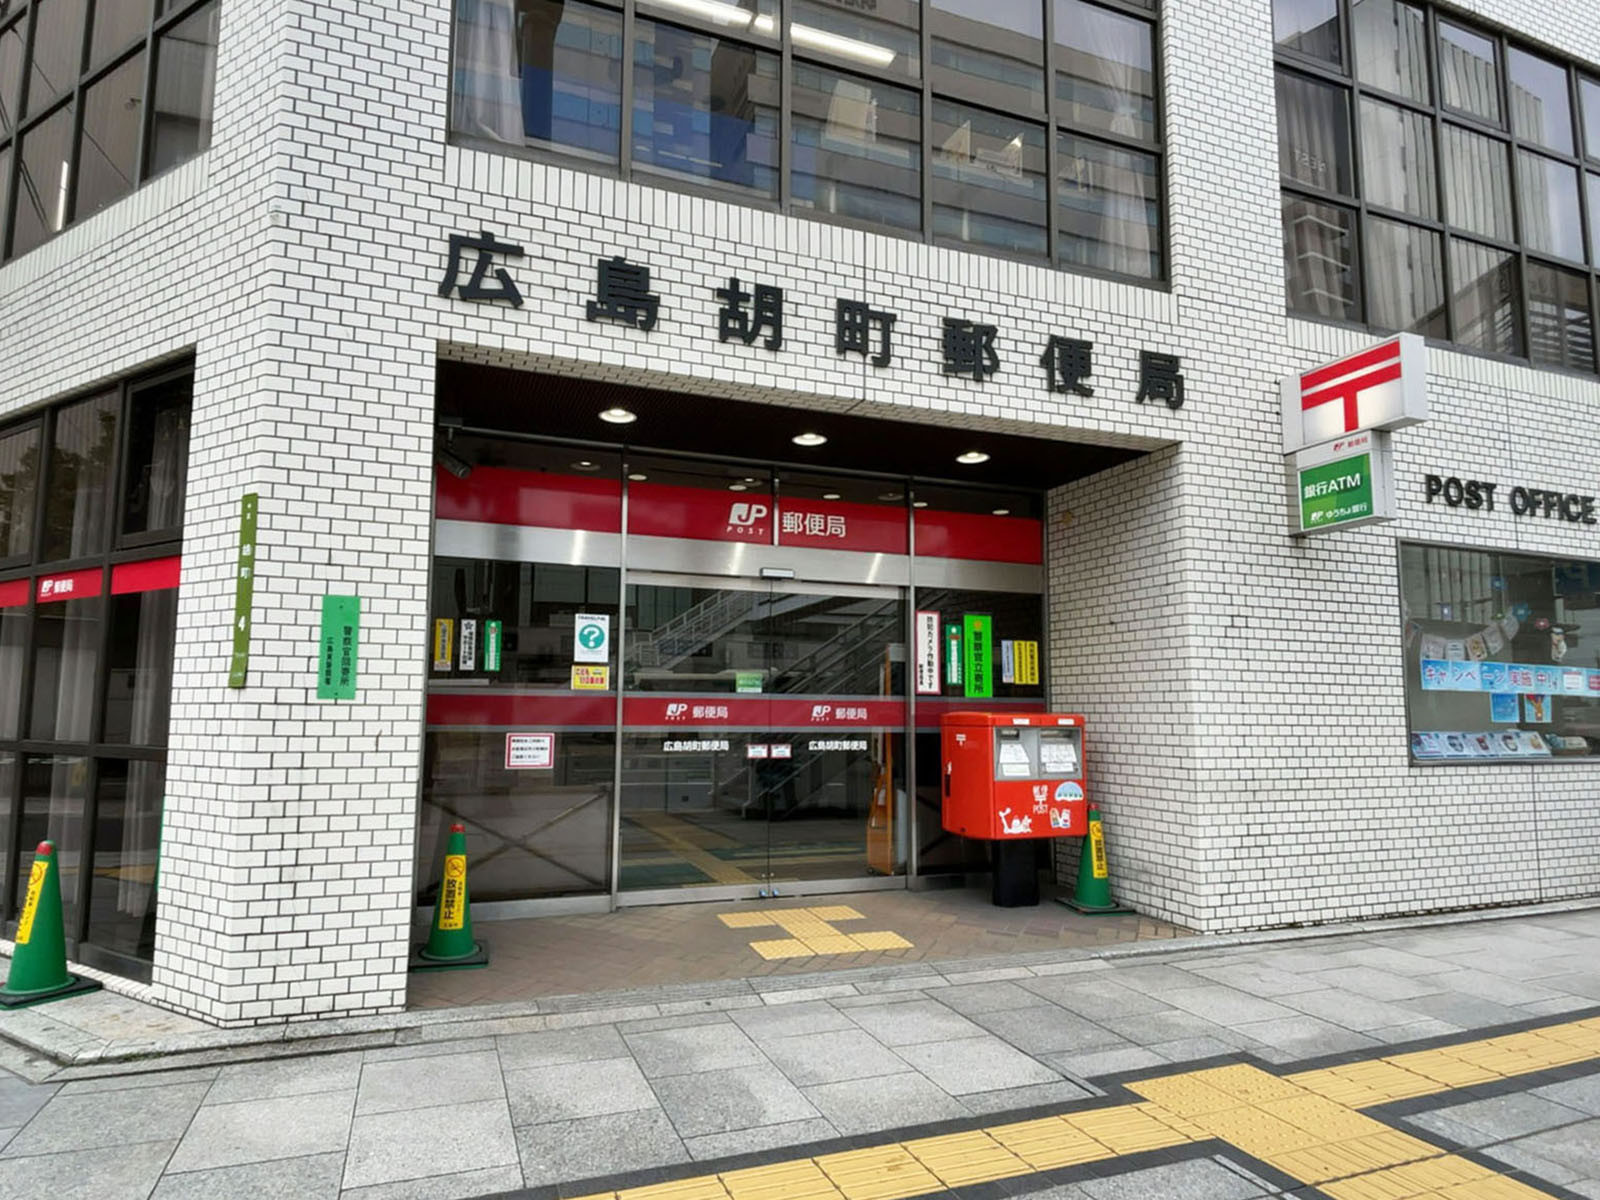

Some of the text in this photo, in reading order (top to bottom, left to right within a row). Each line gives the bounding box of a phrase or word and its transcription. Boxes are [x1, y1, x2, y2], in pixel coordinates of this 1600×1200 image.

[438, 231, 1186, 411] 広島胡町郵便局
[1304, 472, 1361, 500] 銀行ATM
[1425, 474, 1597, 525] POST OFFICE
[1325, 502, 1369, 520] ゆうちょ銀行
[726, 526, 764, 535] POST
[782, 511, 846, 538] 郵便局
[238, 615, 246, 632] 4
[692, 706, 728, 719] 郵便局
[835, 707, 868, 720] 郵便局
